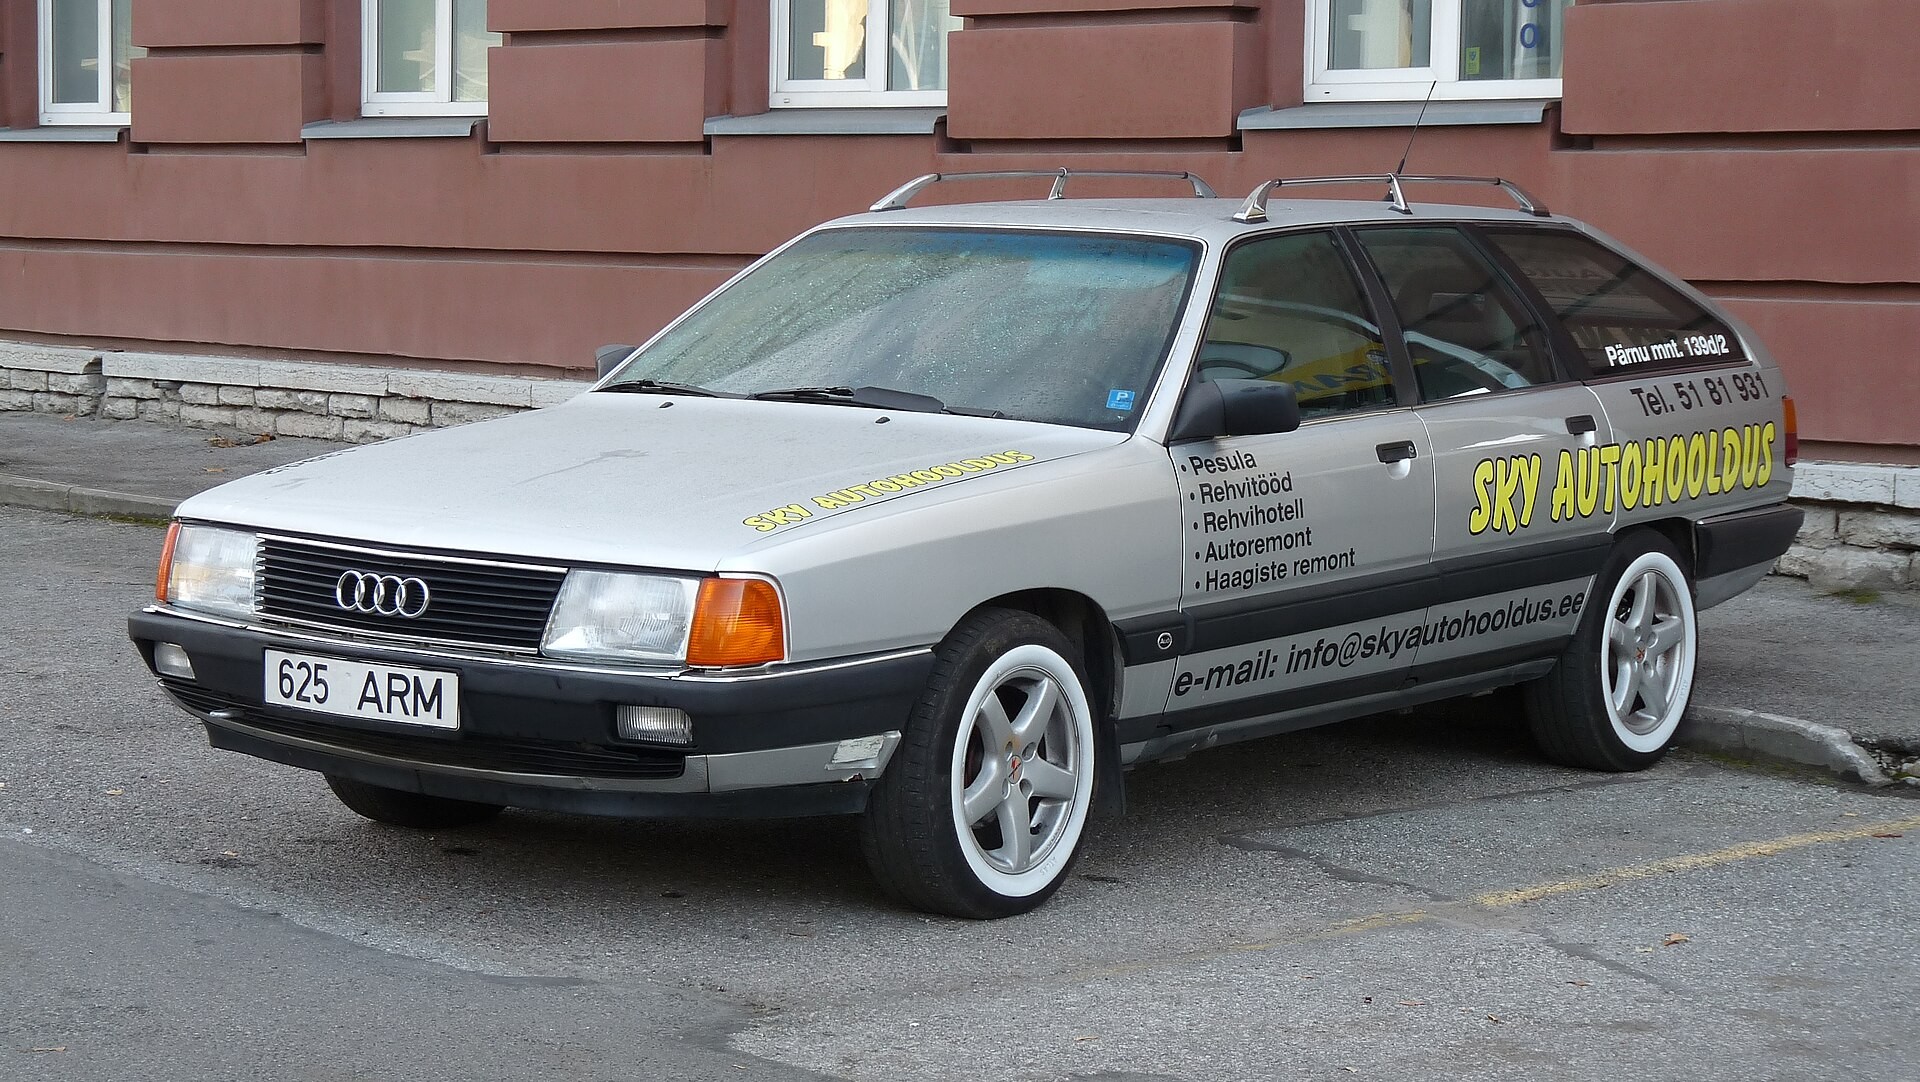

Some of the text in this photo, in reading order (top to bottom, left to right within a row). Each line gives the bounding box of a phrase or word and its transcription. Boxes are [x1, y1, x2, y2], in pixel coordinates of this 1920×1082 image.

[1605, 343, 1651, 367] Pärnu
[1652, 338, 1684, 361] mnt.
[1684, 333, 1730, 357] 139d/2
[1630, 371, 1770, 417] Tel. 51 81 931
[1189, 450, 1257, 476] Pesula
[1468, 421, 1776, 535] SKY AUTOHOOLDUS
[742, 449, 1035, 532] SKY AUTOHOOLDUS
[1199, 471, 1293, 504] Rehvitööd
[1203, 498, 1304, 533] Rehvihotell
[1204, 526, 1312, 563] Autoremont
[1206, 547, 1355, 592] Haagiste remont
[1175, 592, 1585, 696] e-mail: info@skyautohooldus.ee
[278, 659, 444, 720] 625 ARM
